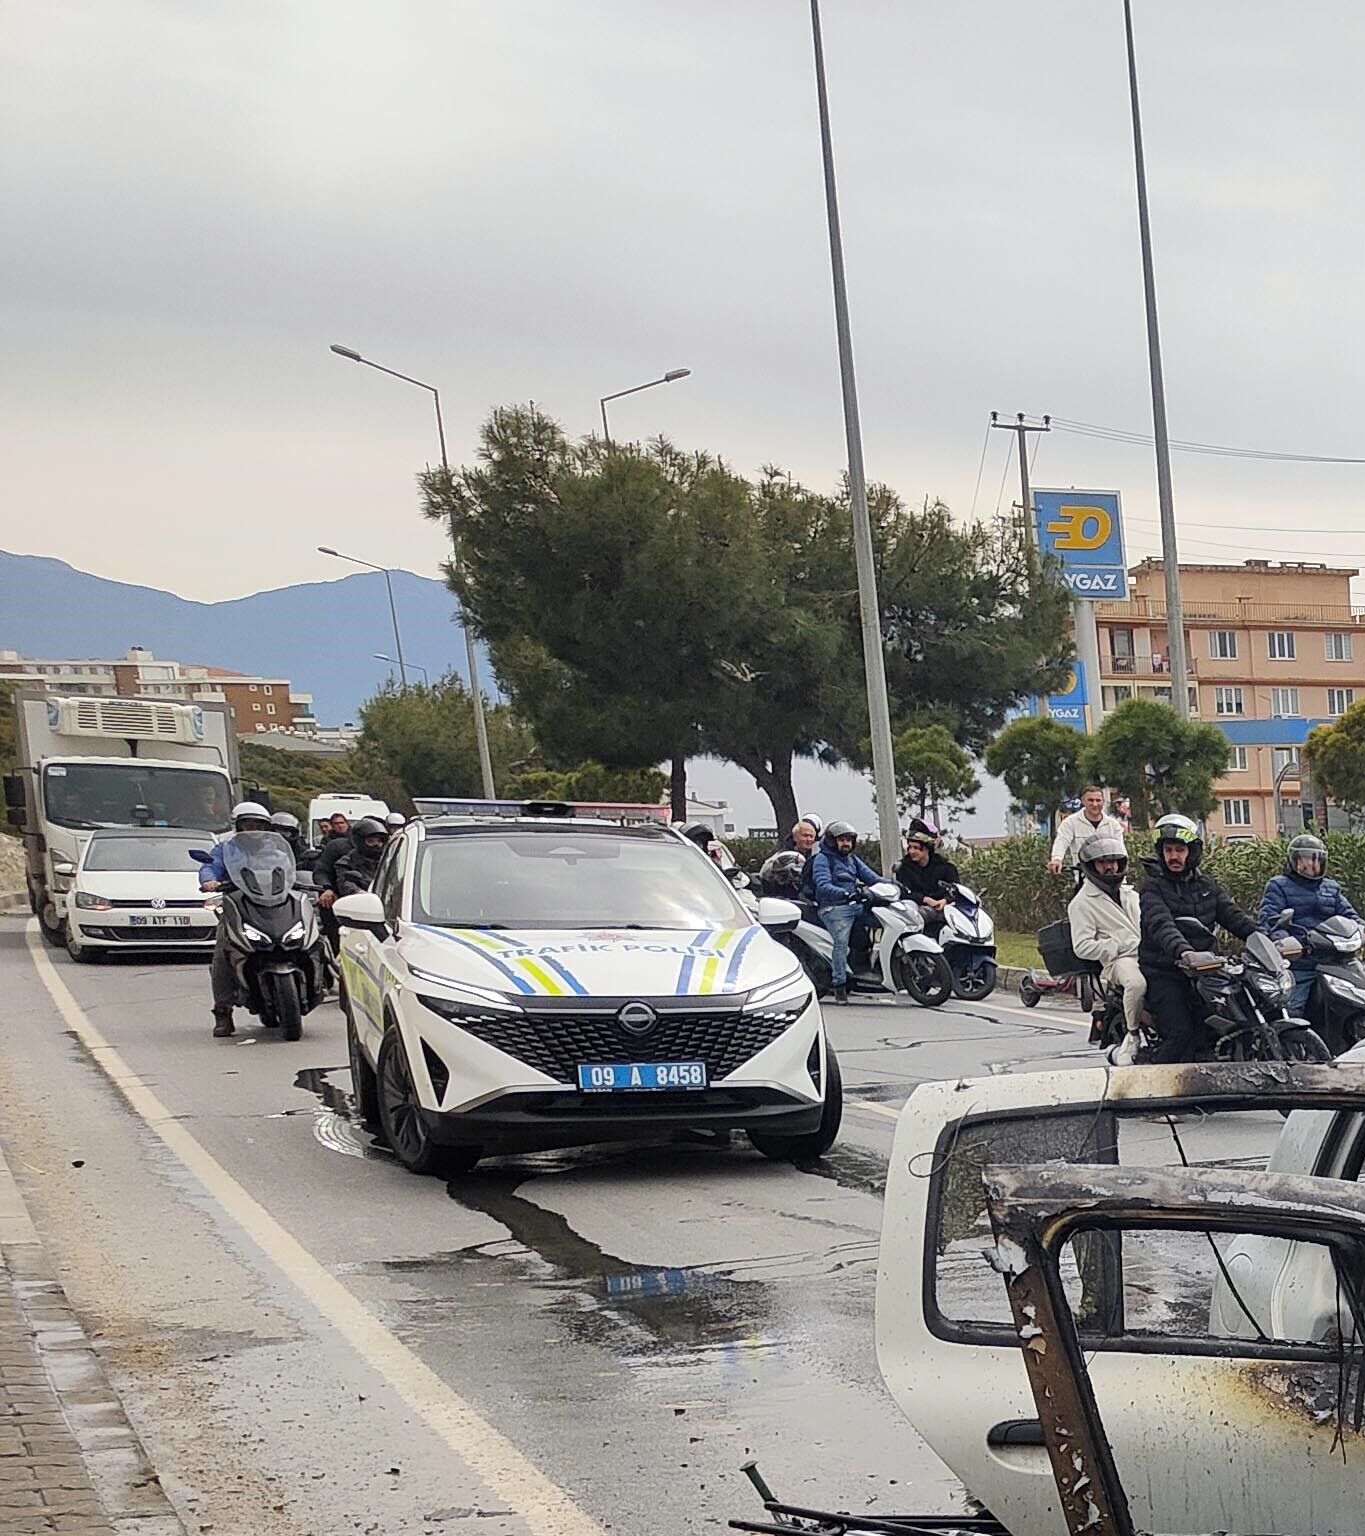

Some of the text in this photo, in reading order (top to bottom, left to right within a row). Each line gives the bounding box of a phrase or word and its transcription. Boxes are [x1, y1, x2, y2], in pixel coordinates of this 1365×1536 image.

[1063, 574, 1118, 591] YGAZ
[1049, 708, 1080, 719] YGAZ
[591, 1065, 701, 1086] 09 A 8458
